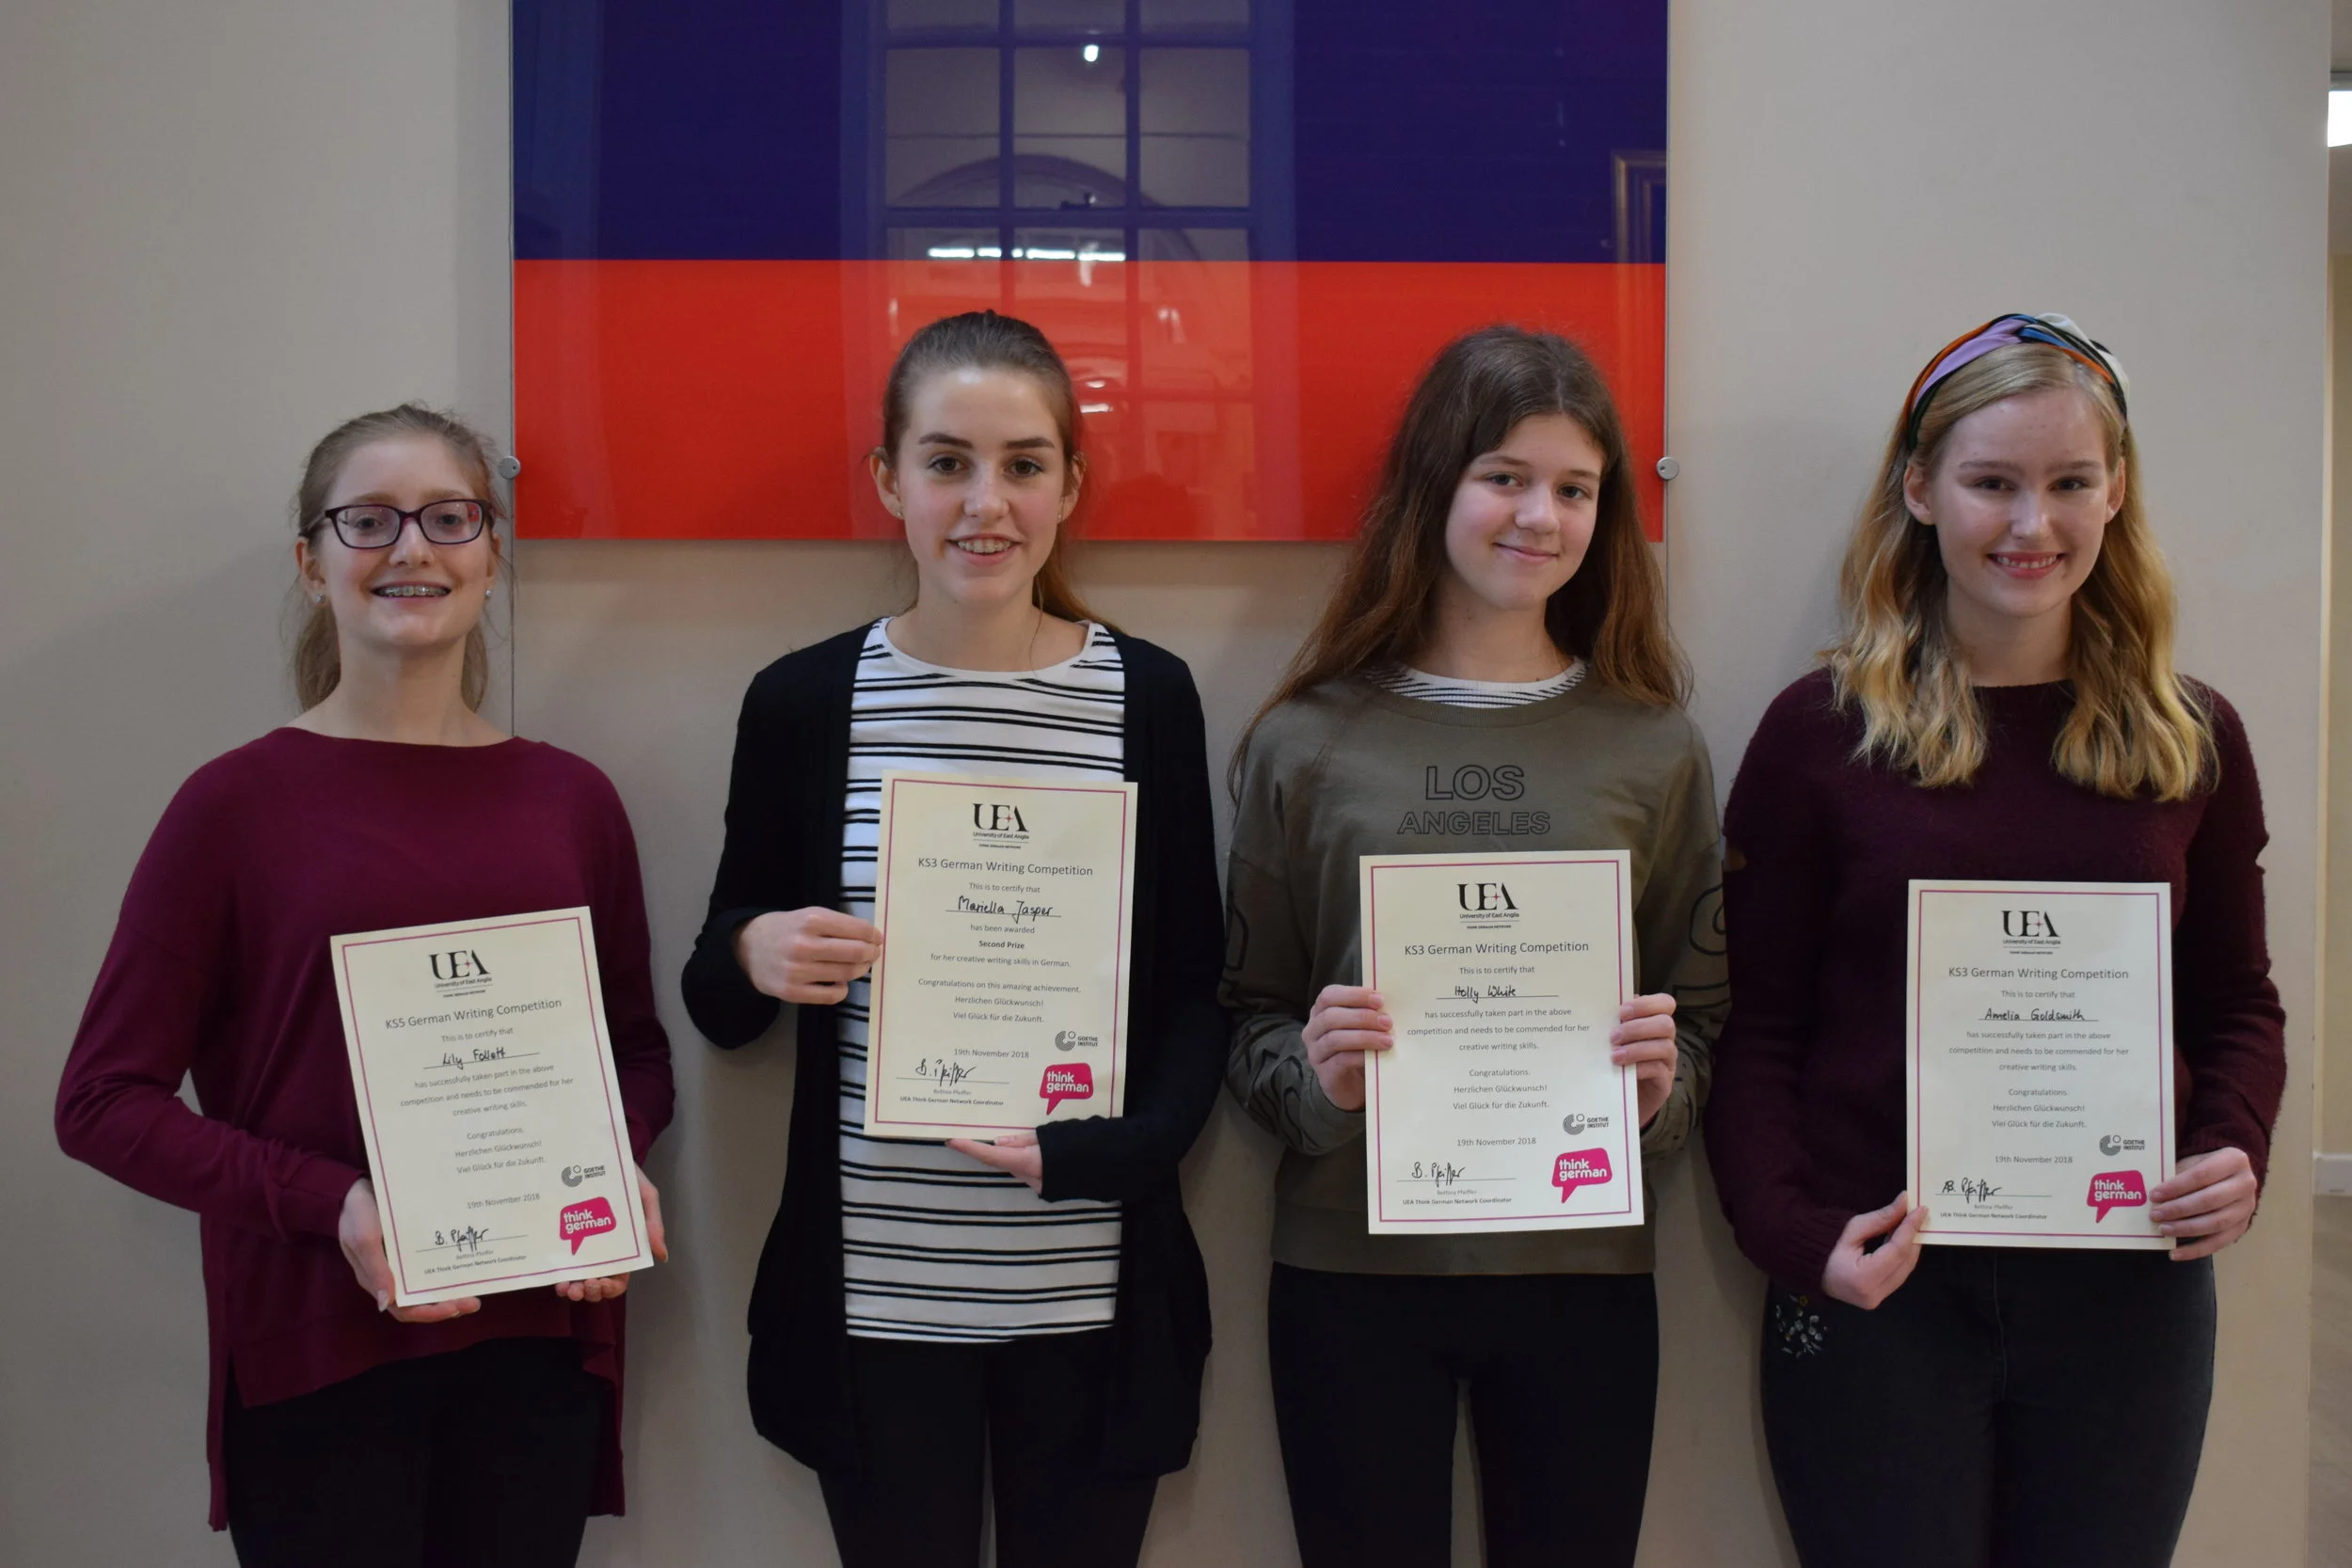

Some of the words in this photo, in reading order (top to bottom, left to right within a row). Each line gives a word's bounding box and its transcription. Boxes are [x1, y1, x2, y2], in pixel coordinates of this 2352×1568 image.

[1424, 764, 1525, 800] LOS
[973, 803, 1029, 832] UEA
[1397, 811, 1550, 835] ANGELES
[918, 858, 937, 867] KS3
[940, 858, 982, 870] German
[985, 861, 1025, 875] Writing
[1027, 863, 1092, 876] Competition
[1001, 884, 1024, 894] certify
[1456, 882, 1518, 911] UEA
[958, 895, 1005, 913] Mariella
[1012, 901, 1053, 924] Jasper
[970, 923, 982, 931] has
[2001, 910, 2061, 937] UEA
[978, 940, 1005, 948] Second
[1007, 941, 1025, 949] Prize
[1405, 944, 1424, 955] KS3
[1427, 944, 1471, 955] German
[1475, 942, 1517, 955] Writing
[1519, 941, 1588, 954] Competition
[429, 950, 489, 980] UEA
[986, 956, 1011, 966] writing
[1459, 966, 1474, 974] This
[1493, 965, 1517, 974] certify
[1948, 967, 1968, 976] KS3
[1970, 967, 2014, 977] German
[2017, 968, 2058, 980] Writing
[2060, 968, 2128, 980] Competition
[918, 978, 975, 988] Congratulations
[1002, 984, 1031, 992] amazing
[955, 996, 992, 1005] Herzlichen
[1455, 986, 1480, 1004] Holly
[2034, 990, 2058, 999] certify
[385, 1018, 405, 1029] KS5
[407, 1014, 451, 1026] German
[453, 1007, 494, 1020] Writing
[496, 1000, 562, 1015] Competition
[953, 1011, 966, 1020] Viel
[1439, 1009, 1483, 1018] successfully
[1507, 1009, 1523, 1018] part
[1985, 1008, 2020, 1021] Amelia
[474, 1029, 497, 1038] certify
[1406, 1027, 1453, 1036] competition
[1515, 1024, 1563, 1033] commended
[1490, 1042, 1517, 1051] writing
[972, 1049, 1009, 1057] November
[1010, 1050, 1029, 1058] 2018
[443, 1053, 463, 1069] Lily
[1046, 1071, 1074, 1083] think
[1046, 1080, 1089, 1094] german
[1491, 1101, 1502, 1109] für
[1518, 1136, 1536, 1145] 2018
[1559, 1159, 1589, 1170] think
[2013, 1155, 2052, 1164] November
[1559, 1167, 1607, 1181] german
[2094, 1180, 2124, 1191] think
[467, 1200, 484, 1209] 19th
[485, 1196, 521, 1206] November
[522, 1192, 540, 1201] 2018
[2094, 1188, 2142, 1202] german
[564, 1210, 593, 1223] think
[564, 1216, 612, 1234] german
